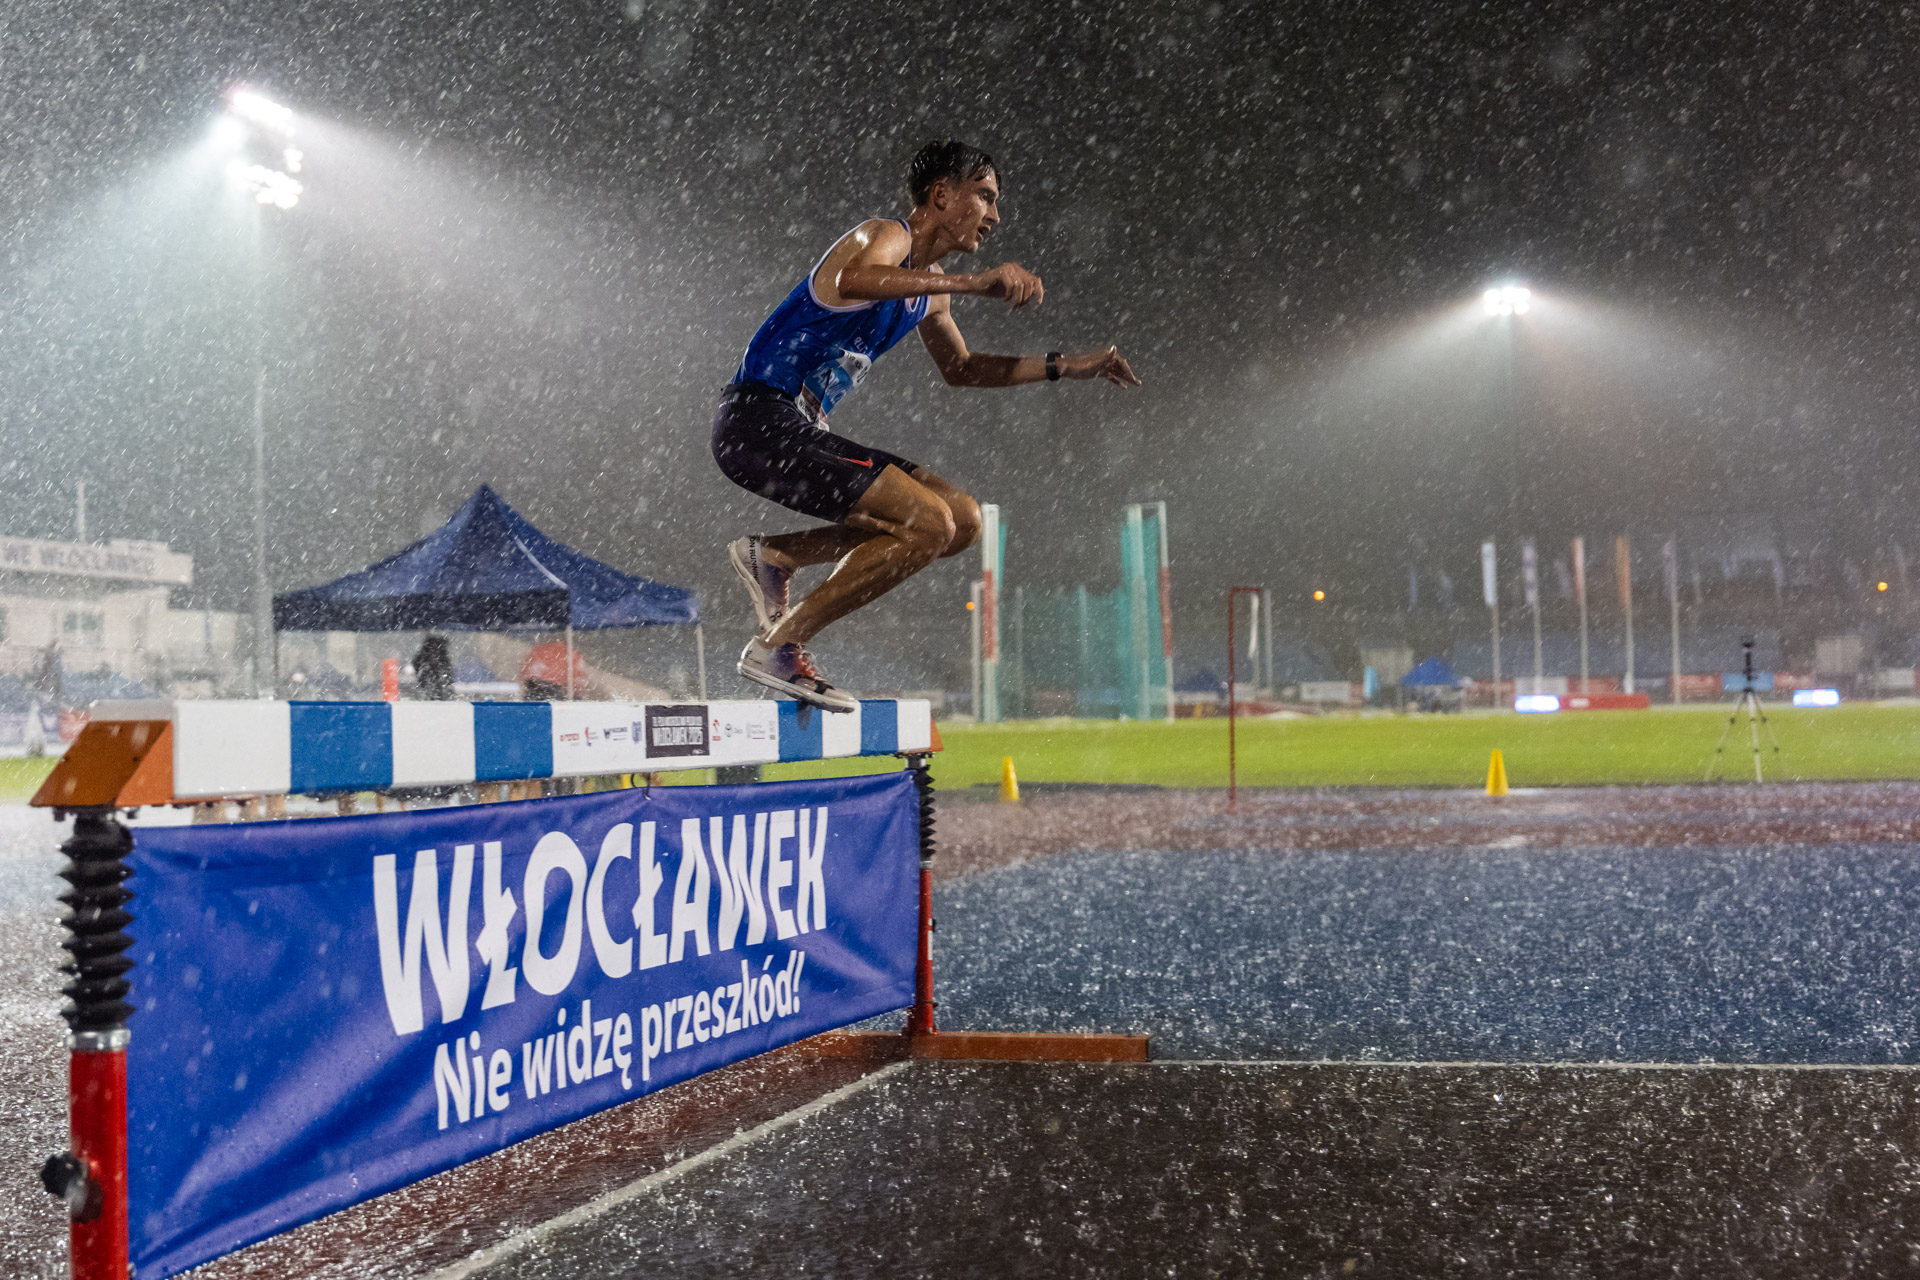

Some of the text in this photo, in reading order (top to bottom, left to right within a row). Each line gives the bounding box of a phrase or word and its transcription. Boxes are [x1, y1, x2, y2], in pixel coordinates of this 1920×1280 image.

[373, 806, 828, 1036] WŁOCŁAWEK
[434, 950, 805, 1130] Nie widzę przeszkód!
